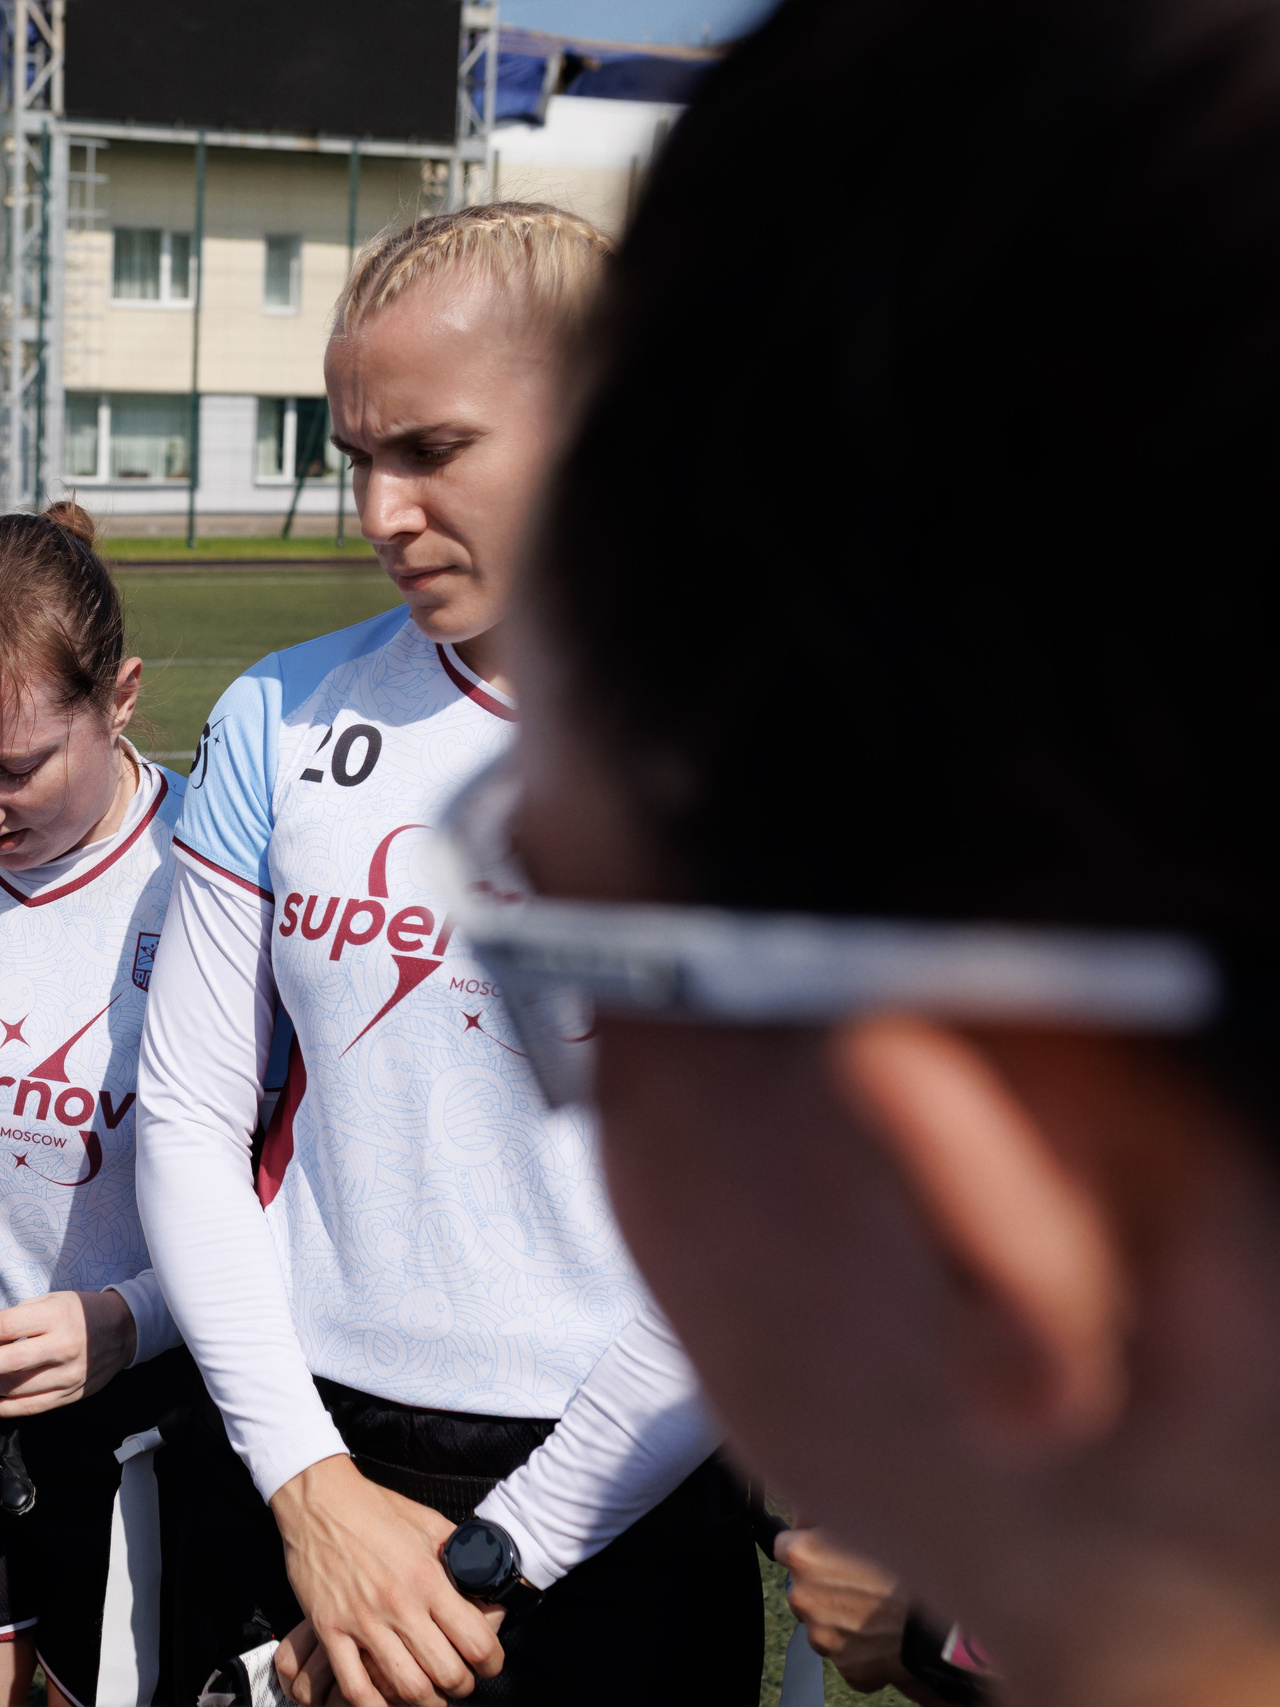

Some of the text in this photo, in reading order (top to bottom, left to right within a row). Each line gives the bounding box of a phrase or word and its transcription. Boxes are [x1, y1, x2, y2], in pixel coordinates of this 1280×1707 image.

[279, 892, 460, 961] super
[450, 976, 502, 999] MOSC
[0, 1126, 67, 1149] MOSCOW
